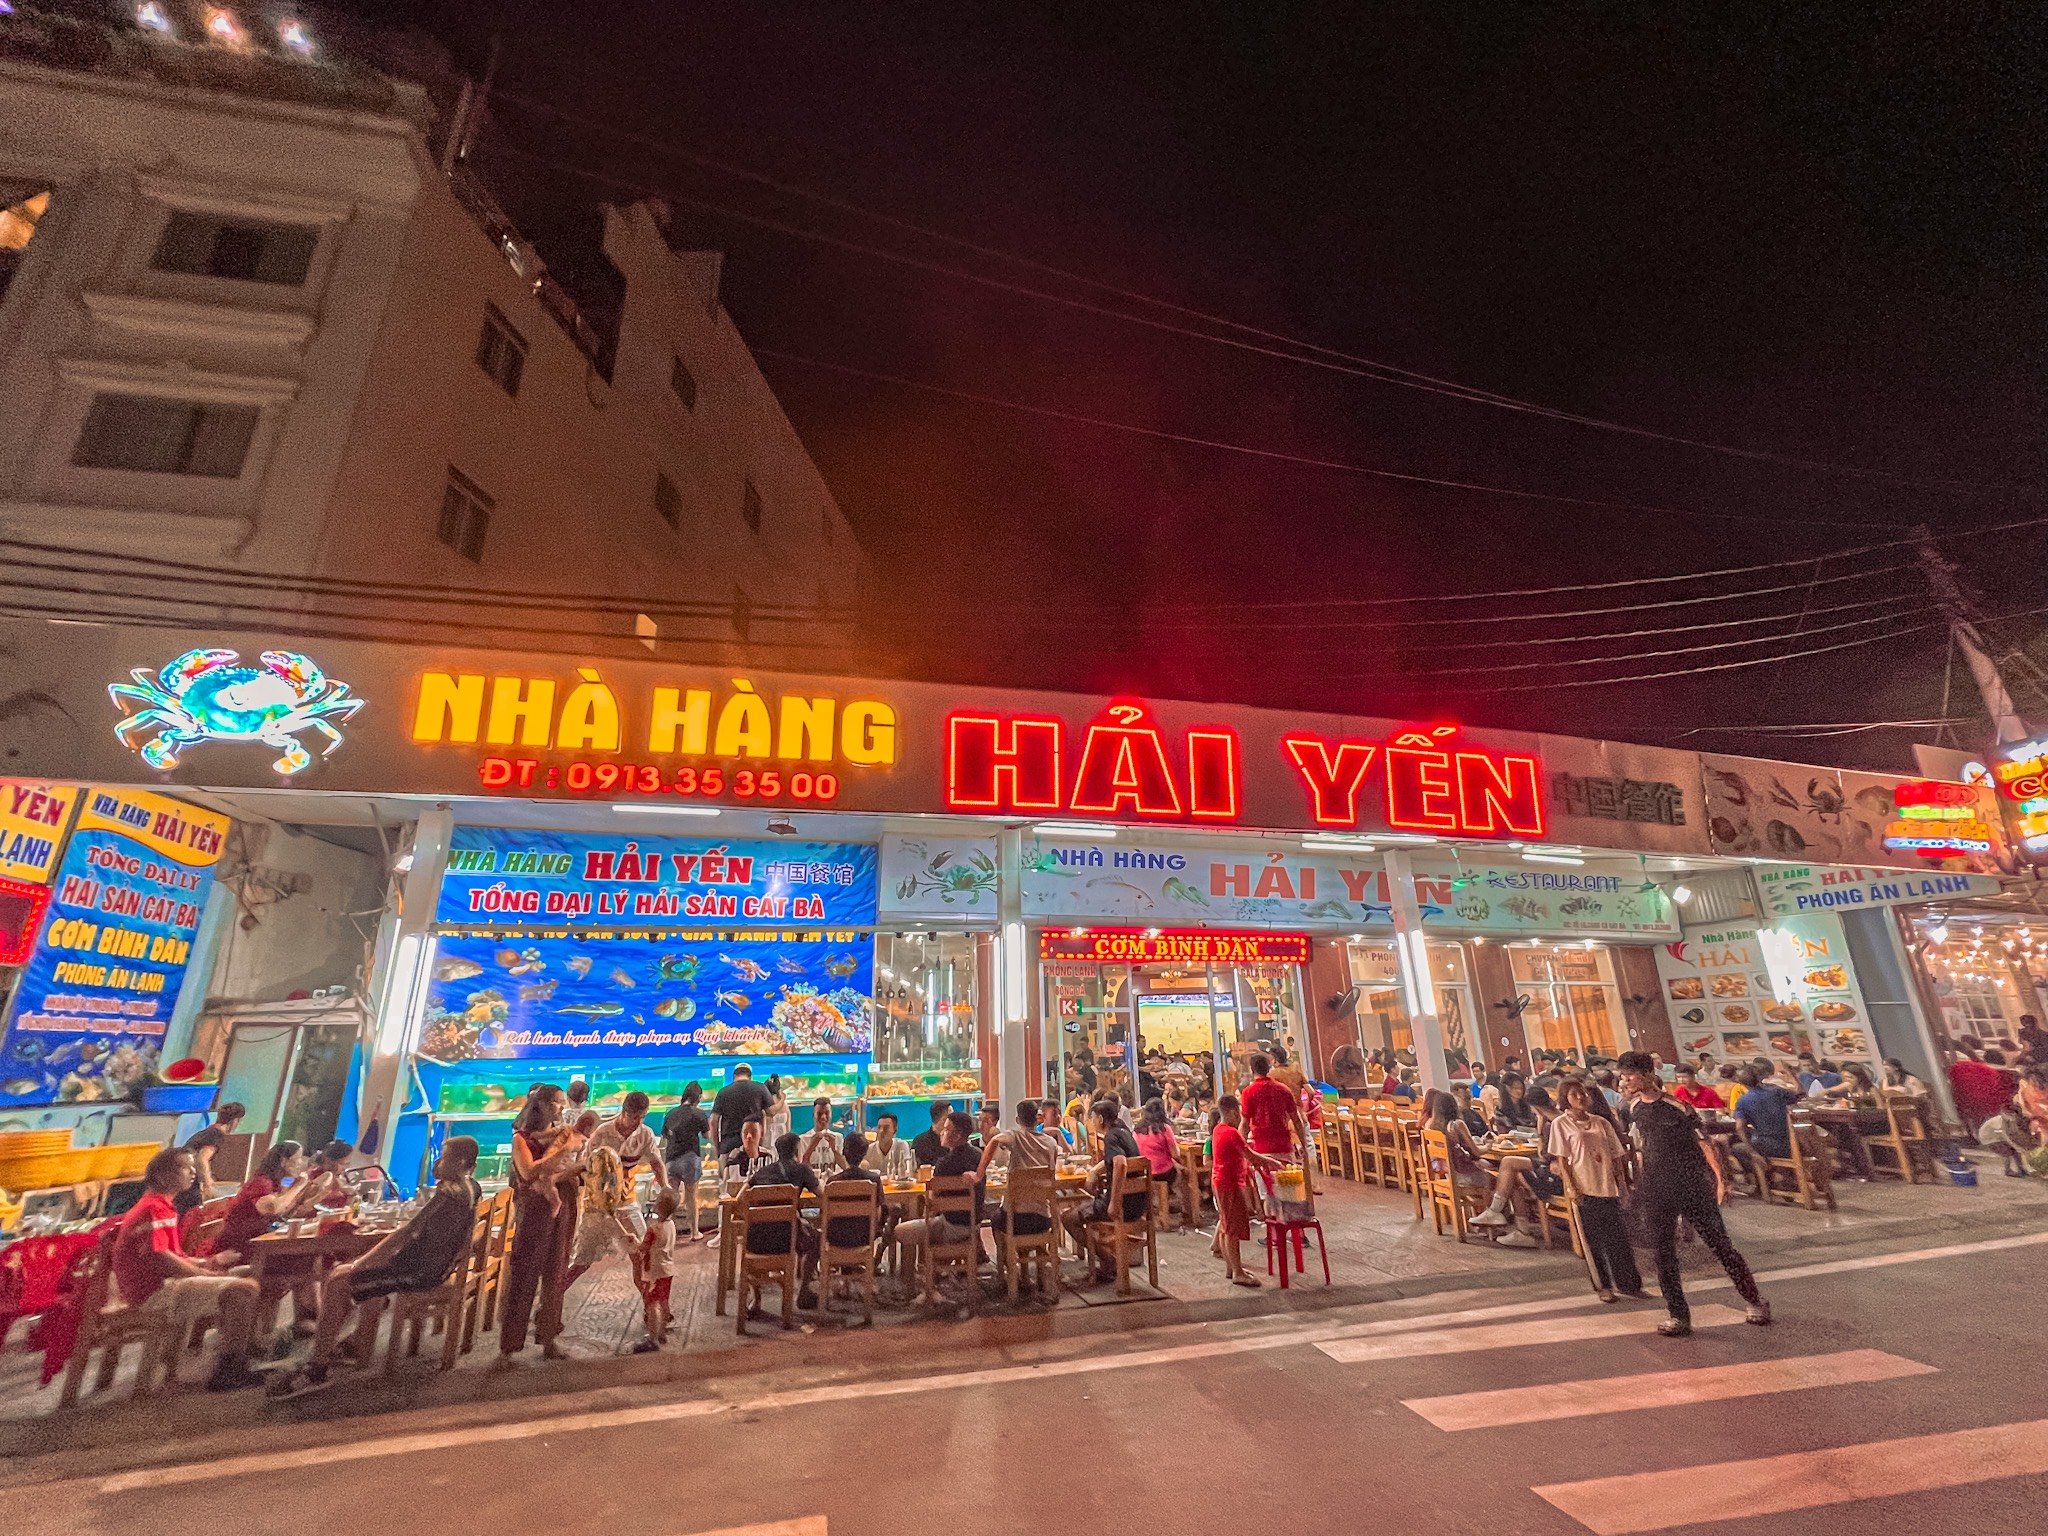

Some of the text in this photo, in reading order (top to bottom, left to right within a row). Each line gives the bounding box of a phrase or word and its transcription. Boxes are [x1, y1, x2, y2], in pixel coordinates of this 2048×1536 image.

[413, 667, 897, 767] NHÀ HÀNG
[480, 758, 537, 787] ĐT
[567, 762, 722, 797] 0913.35
[734, 770, 781, 797] 35
[791, 773, 837, 800] 00
[949, 705, 1546, 837] HẢI YẾN
[152, 808, 187, 844] HẢI
[188, 821, 222, 856] YẾN
[446, 842, 855, 886] NHÀ HÀNG HẢI YẾN 中国餐馆
[1051, 846, 1186, 870] NHÀ HÀNG
[1210, 852, 1316, 900] HẢI
[470, 882, 826, 919] TỔNG ĐẠI LÝ HẢI SẢN CÁT BÀ
[1487, 870, 1623, 893] RESTAURANT
[1796, 875, 1970, 910] PHÒNG ĂN LẠNH
[48, 916, 98, 951] CƠM
[1094, 936, 1259, 957] CƠM BÌNH DÂN
